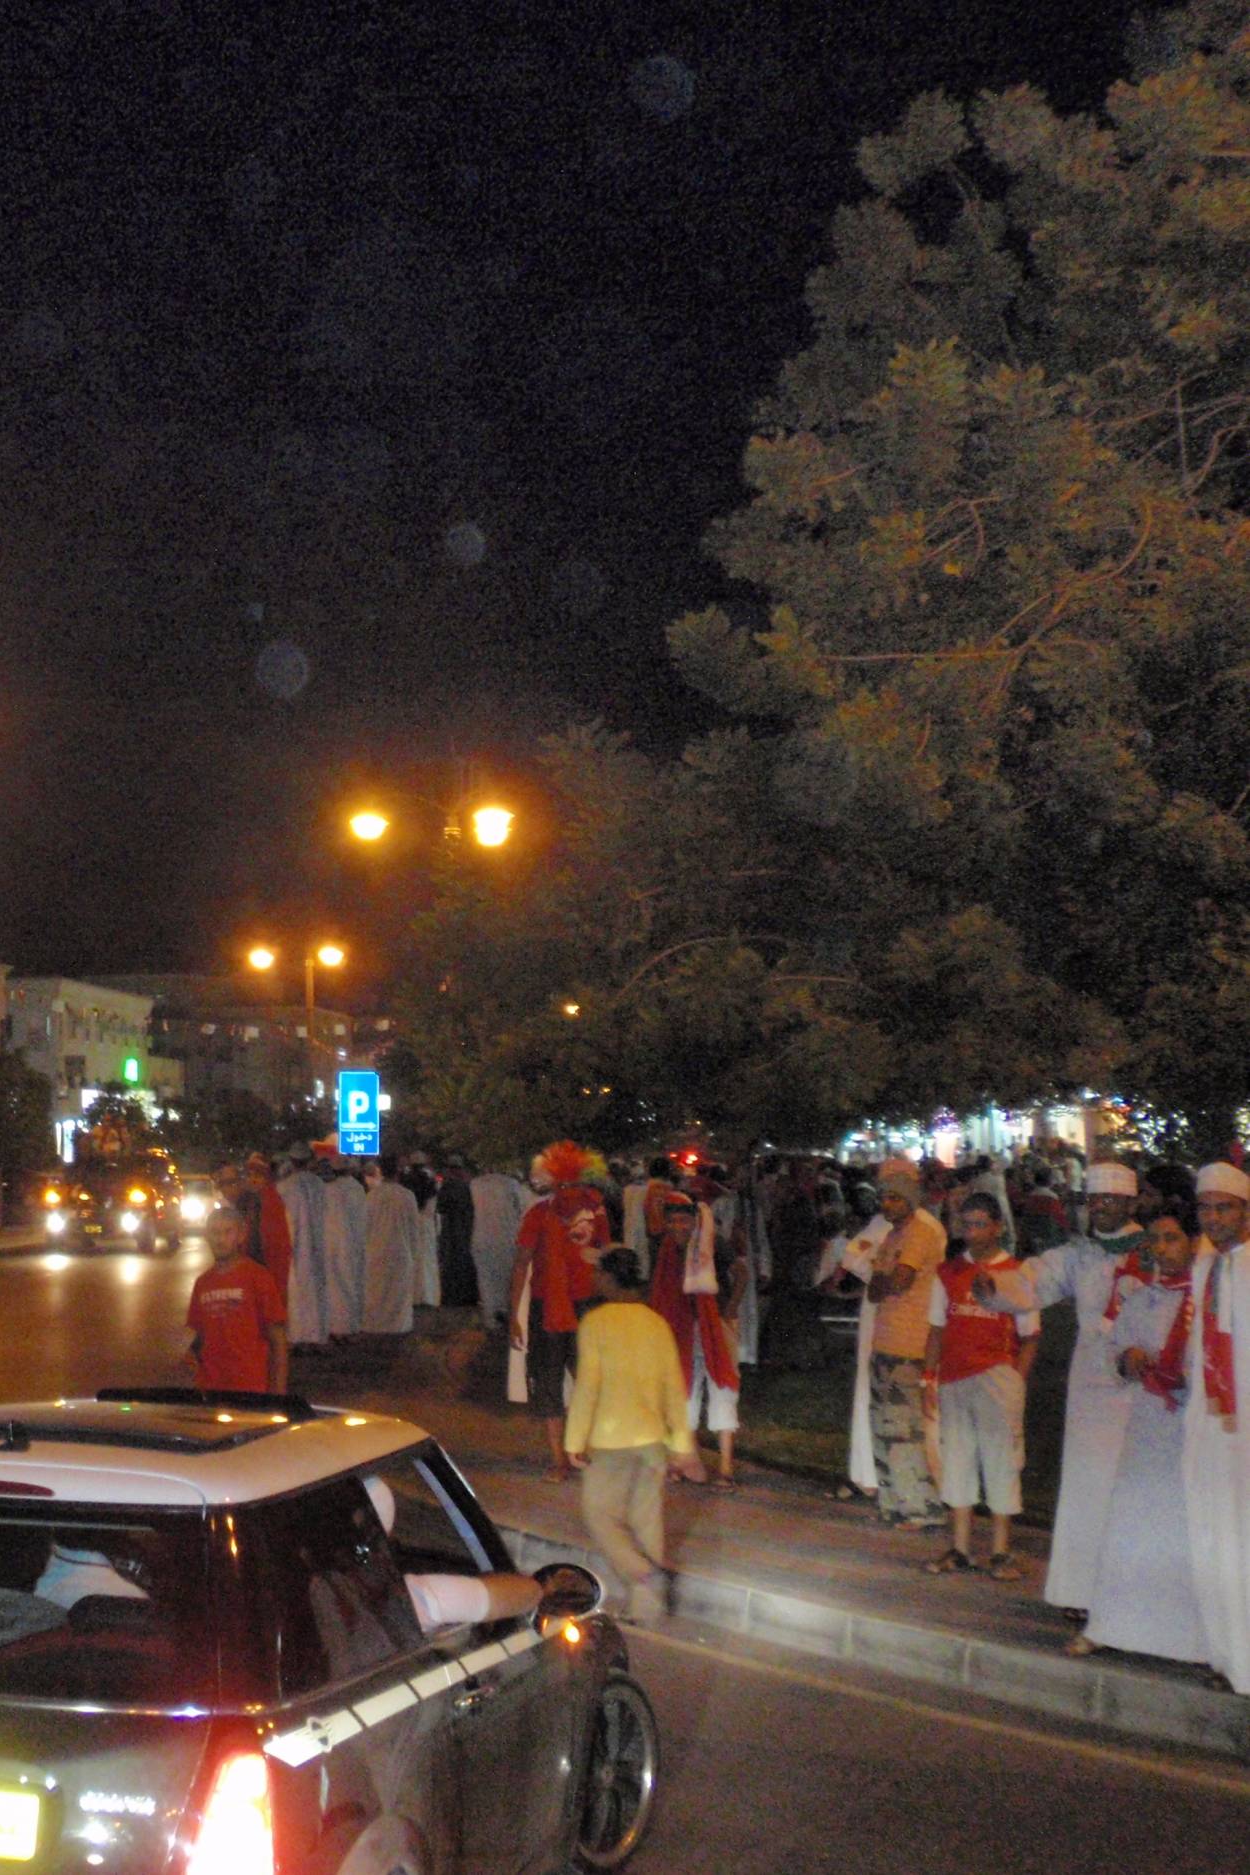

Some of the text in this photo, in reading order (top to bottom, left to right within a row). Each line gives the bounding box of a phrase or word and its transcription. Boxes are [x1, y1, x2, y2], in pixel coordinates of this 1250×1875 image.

[348, 1089, 370, 1122] P
[345, 1132, 373, 1143] دخول
[353, 1143, 365, 1152] IN
